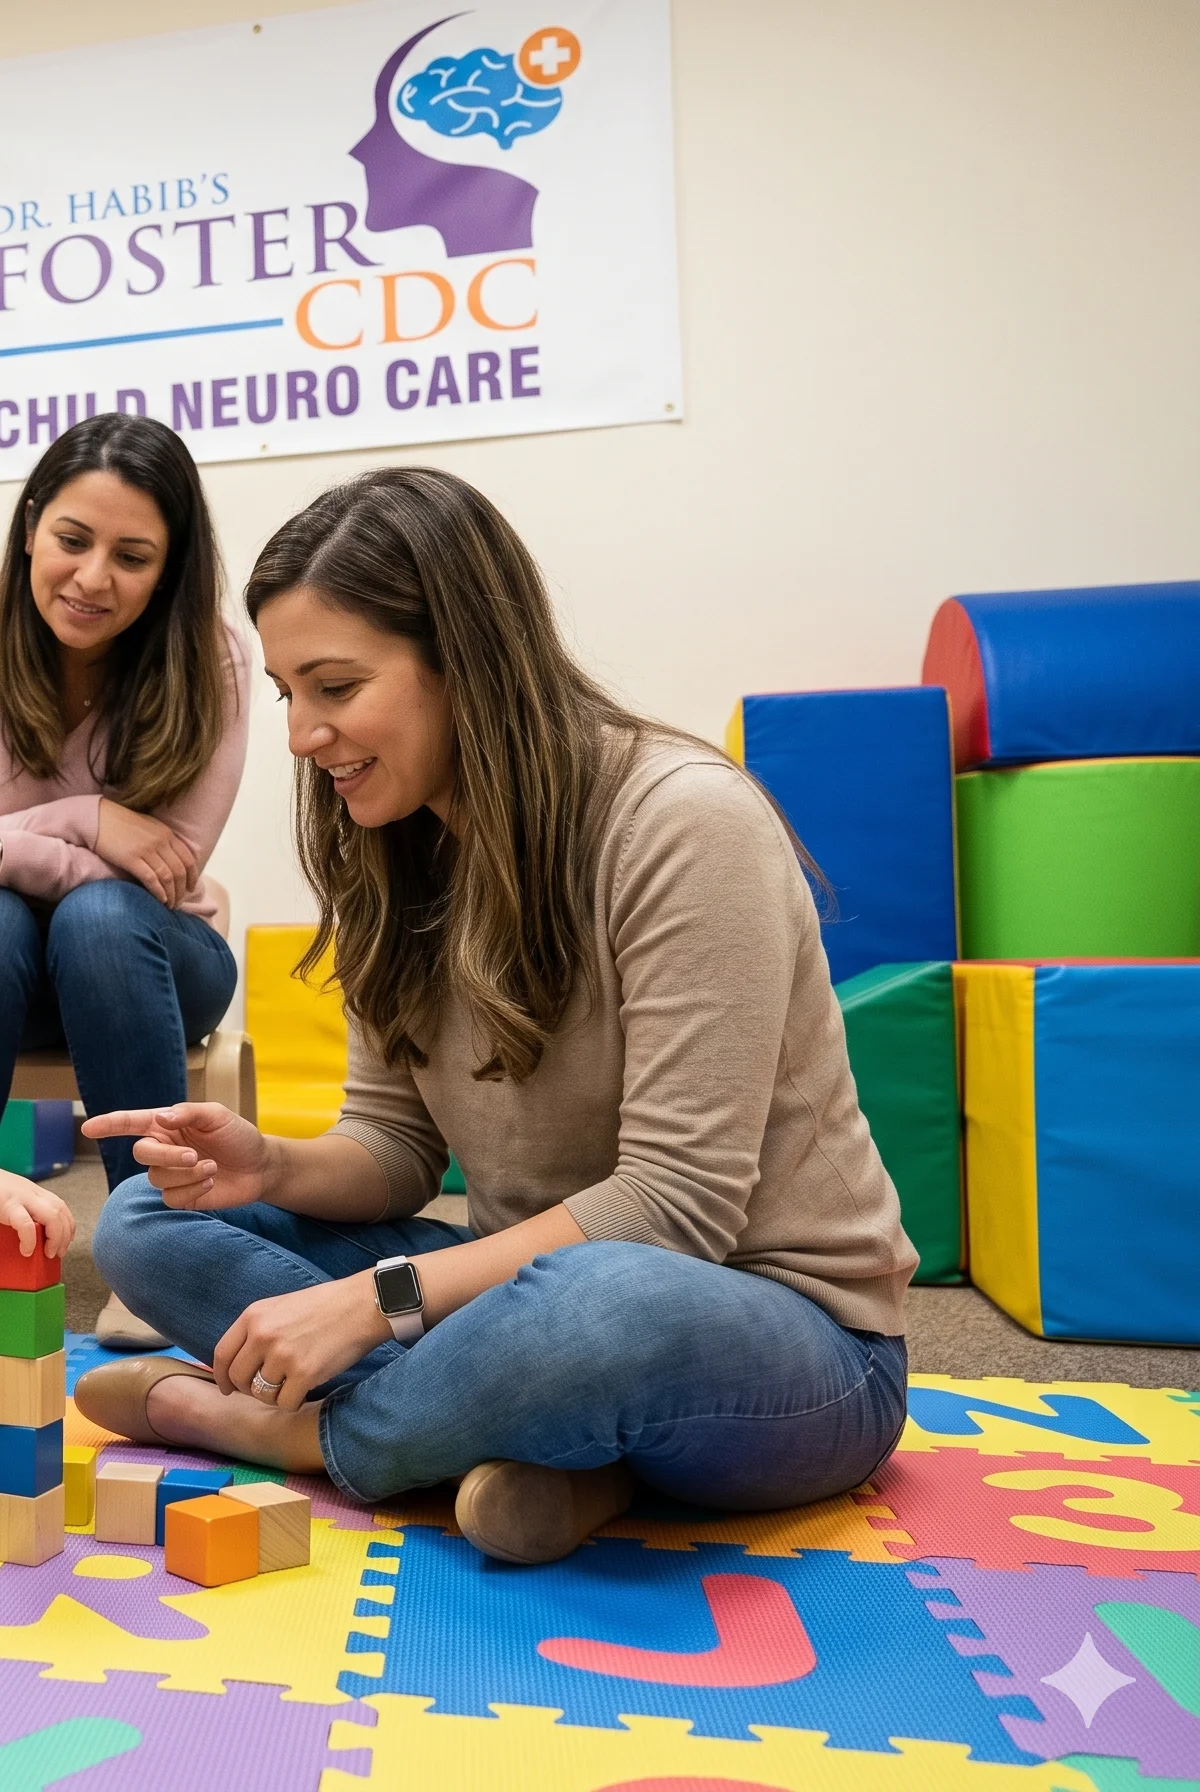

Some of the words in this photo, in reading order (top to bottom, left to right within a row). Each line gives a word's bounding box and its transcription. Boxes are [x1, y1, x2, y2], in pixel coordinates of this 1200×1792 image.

[68, 173, 230, 224] HABIB'S
[295, 258, 539, 351] CDC
[172, 366, 360, 432] NEURO
[386, 346, 541, 411] CARE
[982, 1470, 1200, 1552] 3
[537, 1573, 817, 1688] J
